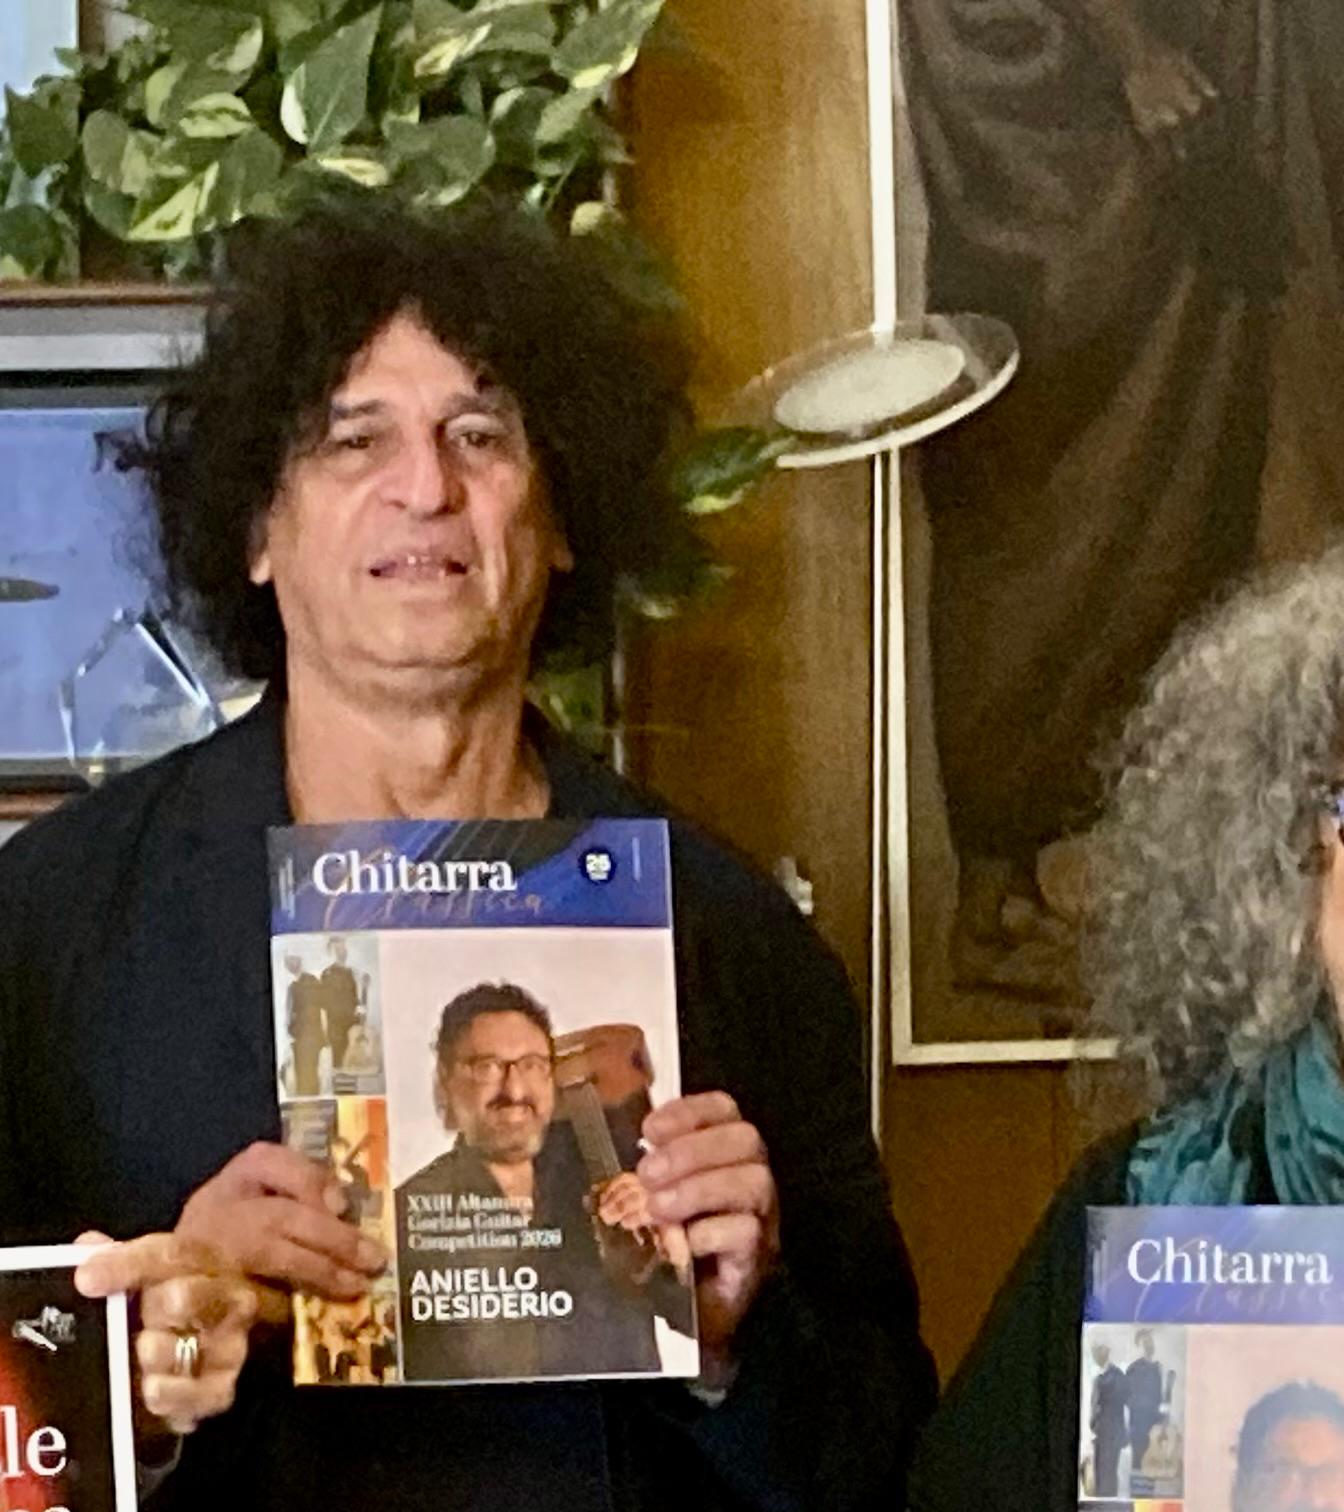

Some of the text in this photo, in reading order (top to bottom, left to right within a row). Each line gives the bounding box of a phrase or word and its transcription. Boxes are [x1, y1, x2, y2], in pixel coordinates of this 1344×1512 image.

[313, 849, 517, 895] Chitarra
[410, 1266, 538, 1294] ANIELLO
[1127, 1237, 1333, 1286] Chitarra
[412, 1290, 574, 1322] DESIDERIO
